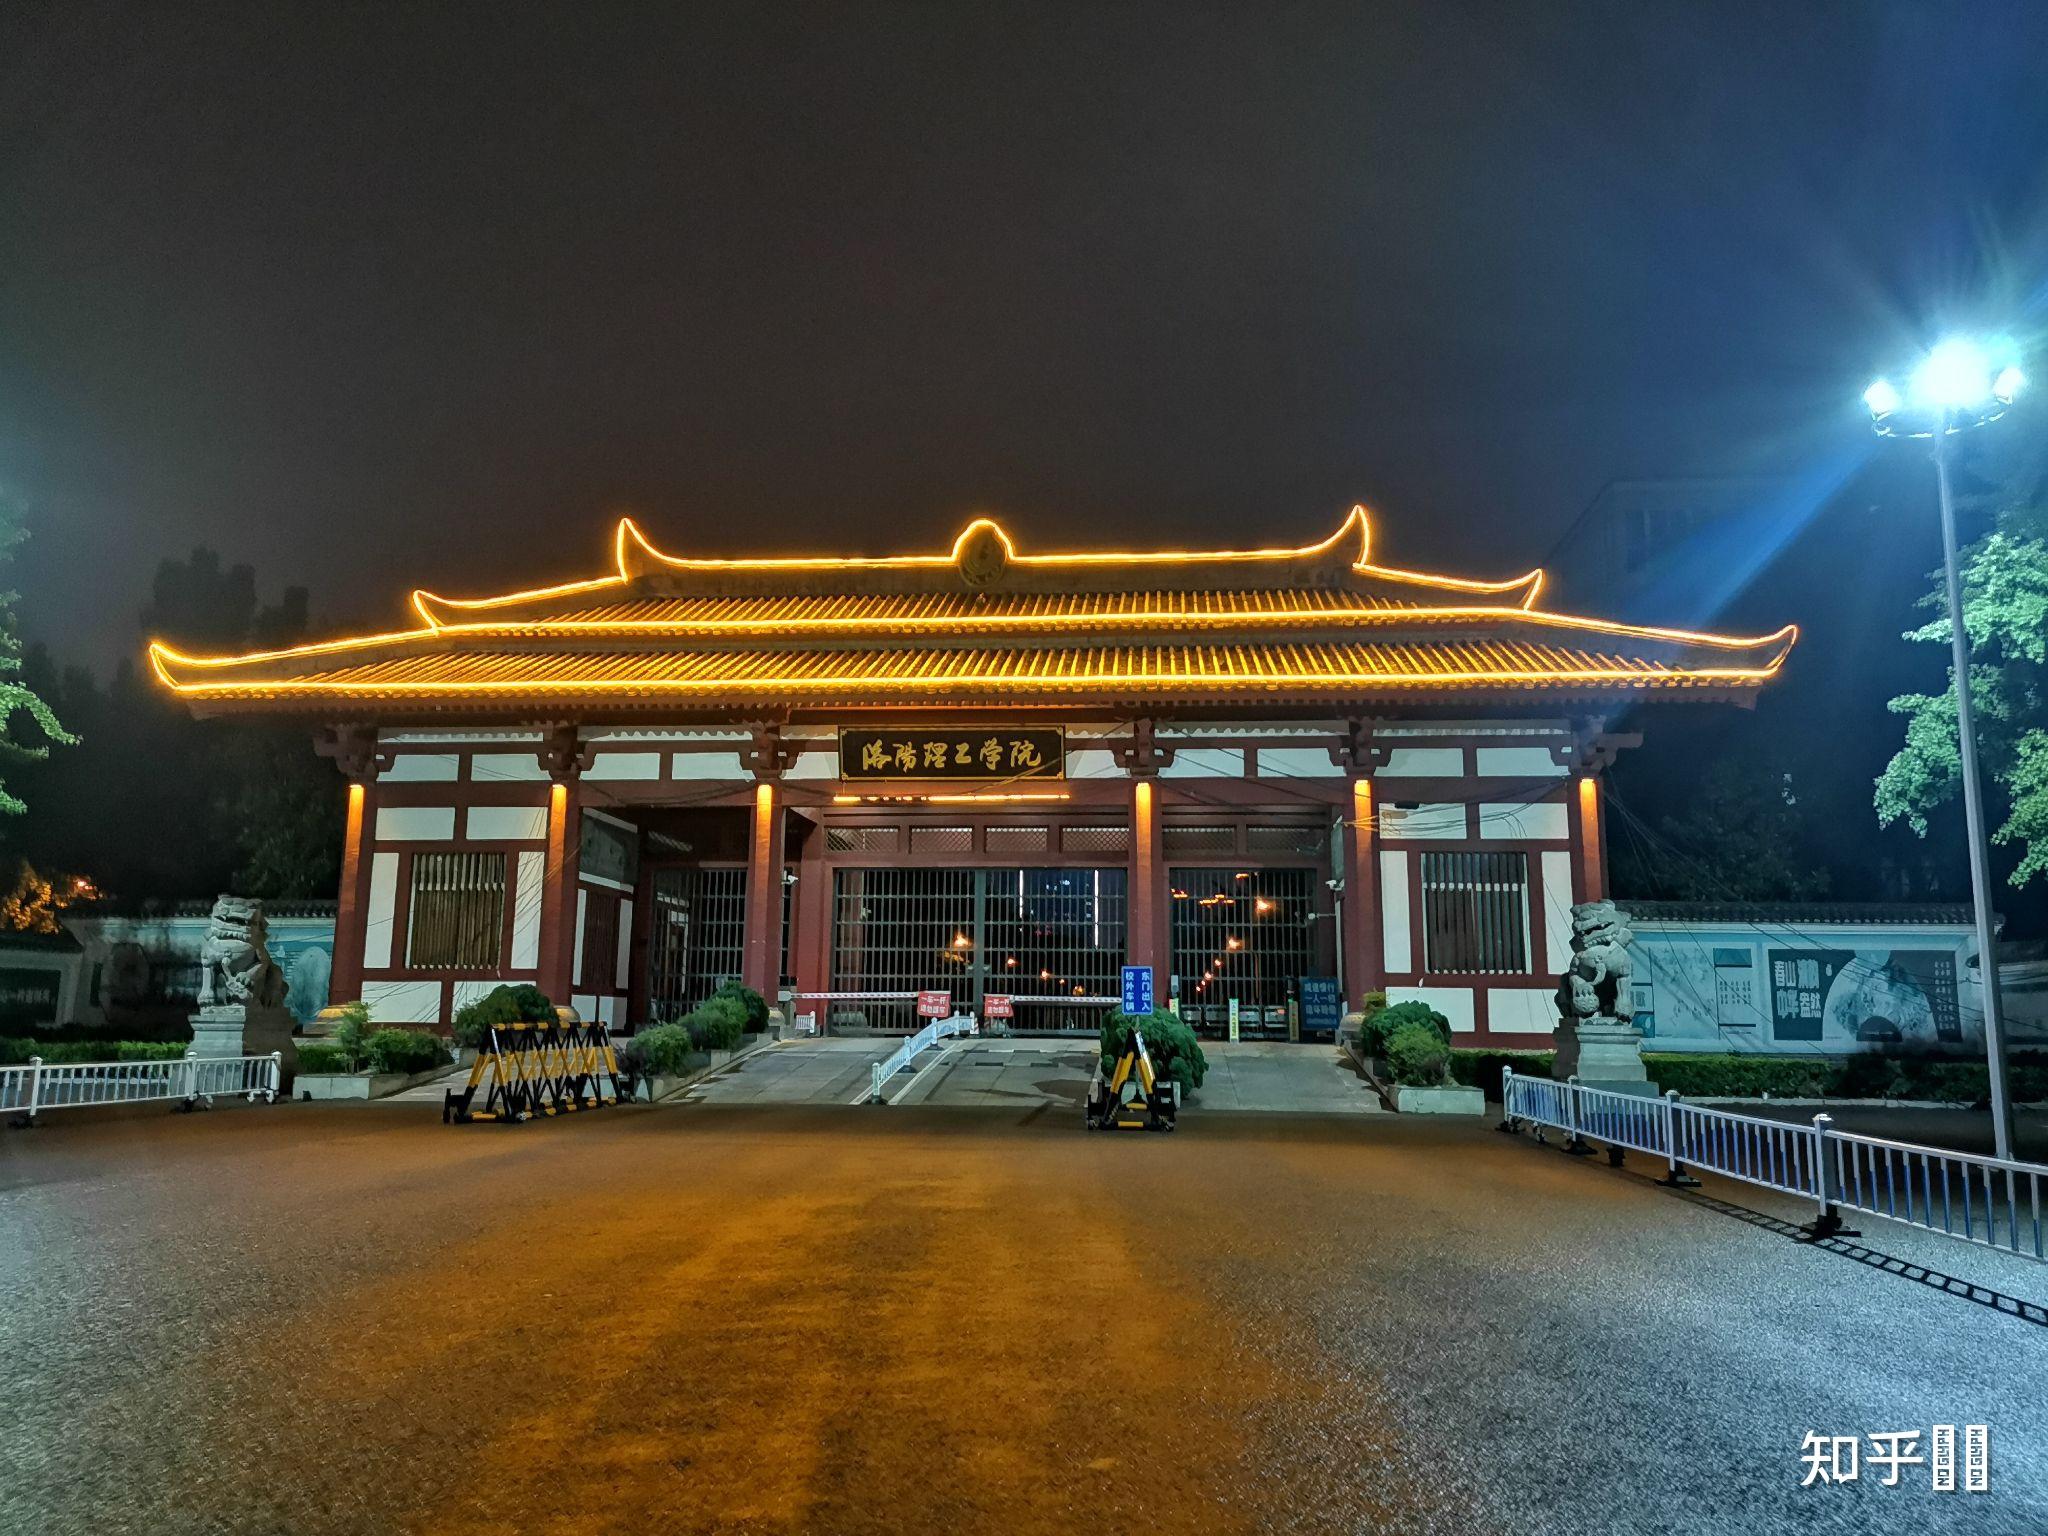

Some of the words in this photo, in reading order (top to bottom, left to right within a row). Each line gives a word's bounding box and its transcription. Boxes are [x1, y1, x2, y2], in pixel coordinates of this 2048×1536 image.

[1125, 971, 1135, 1012] 校外车辆
[1141, 971, 1151, 1011] 东门出入
